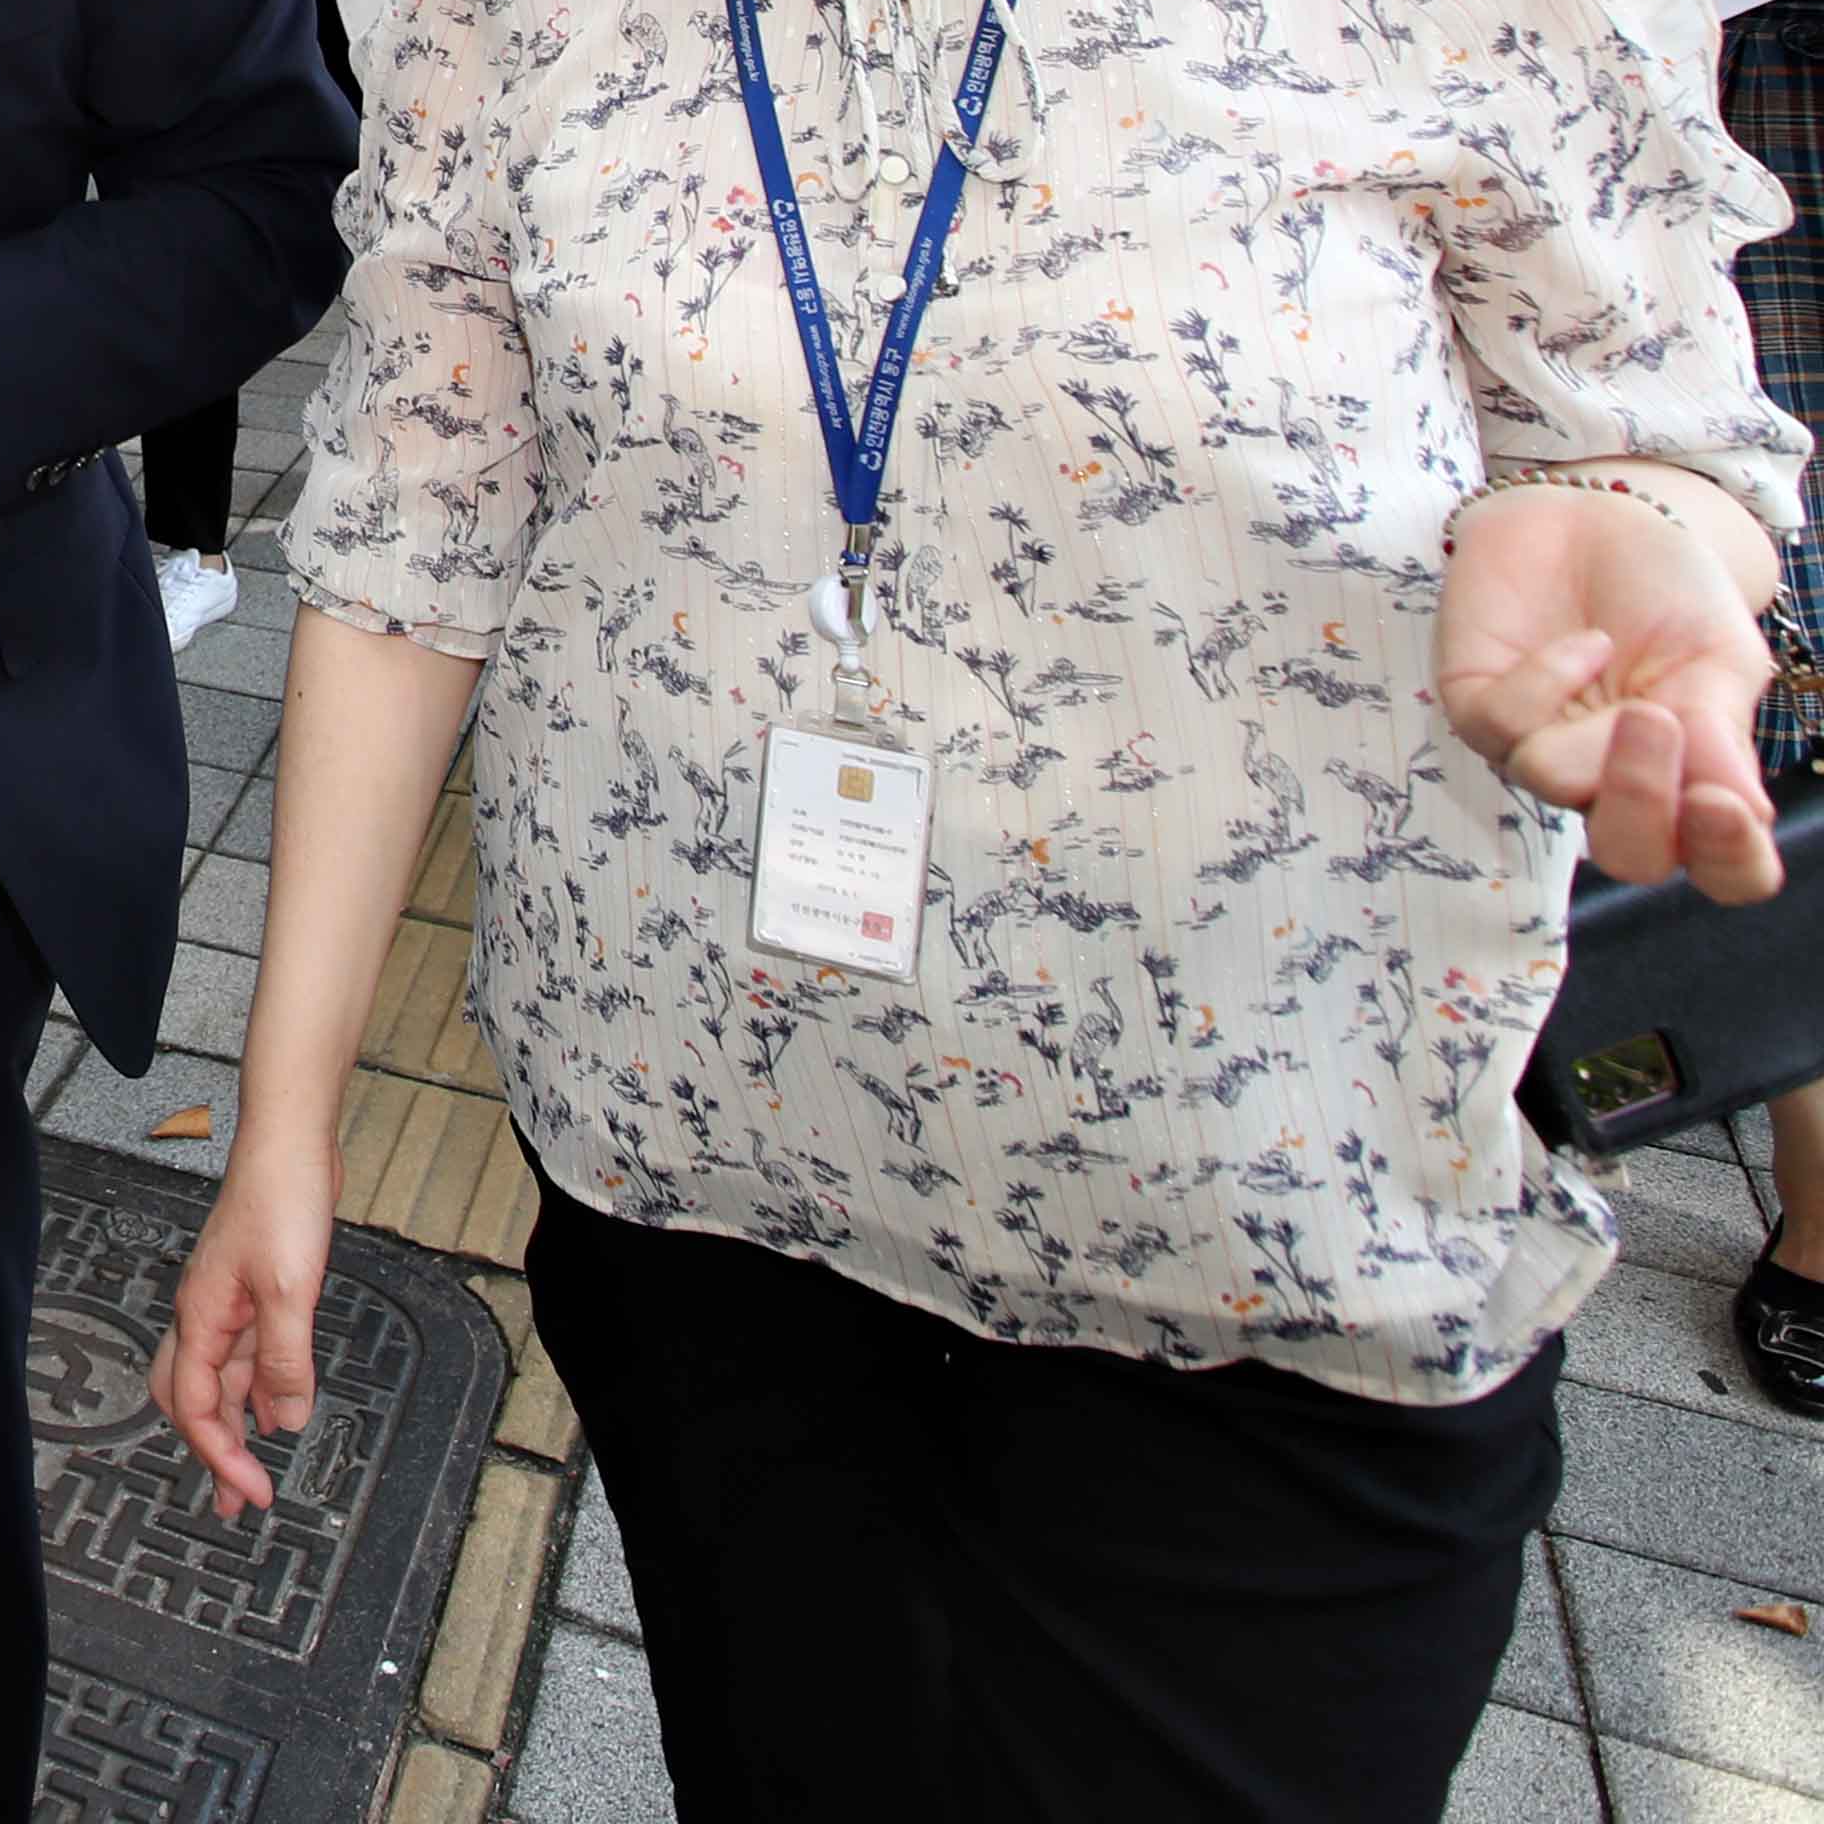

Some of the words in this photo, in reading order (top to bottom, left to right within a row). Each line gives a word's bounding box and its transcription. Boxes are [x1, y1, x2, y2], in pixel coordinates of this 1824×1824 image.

[966, 26, 1001, 95] 인천광역시
[780, 220, 811, 284] 인천광역시
[865, 379, 896, 450] 인천광역시
[881, 348, 904, 377] 동구
